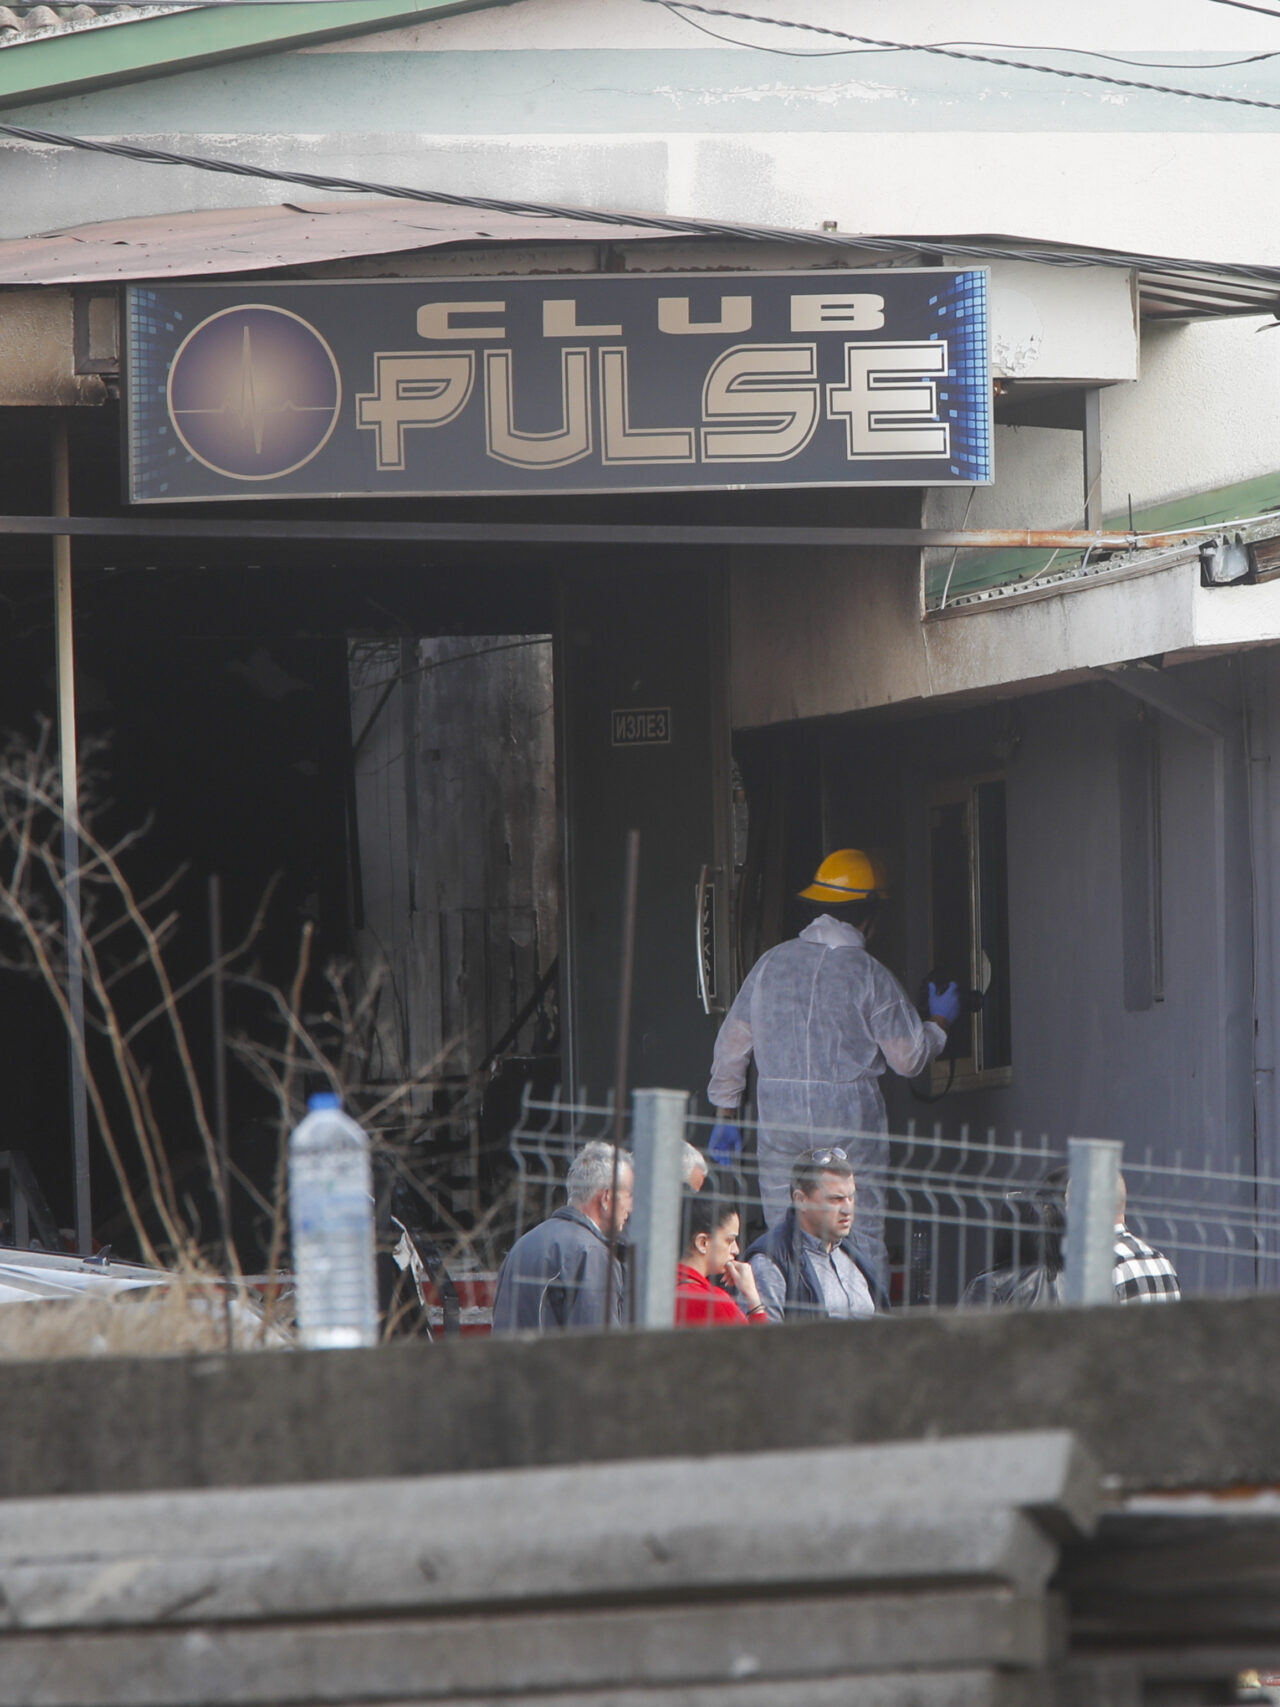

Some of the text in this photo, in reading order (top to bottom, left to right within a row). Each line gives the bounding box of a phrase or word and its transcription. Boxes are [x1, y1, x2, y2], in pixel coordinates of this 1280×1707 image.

[416, 292, 886, 340] CLUB
[355, 339, 950, 471] PULSE
[615, 713, 666, 739] ИЗЛЕЗ
